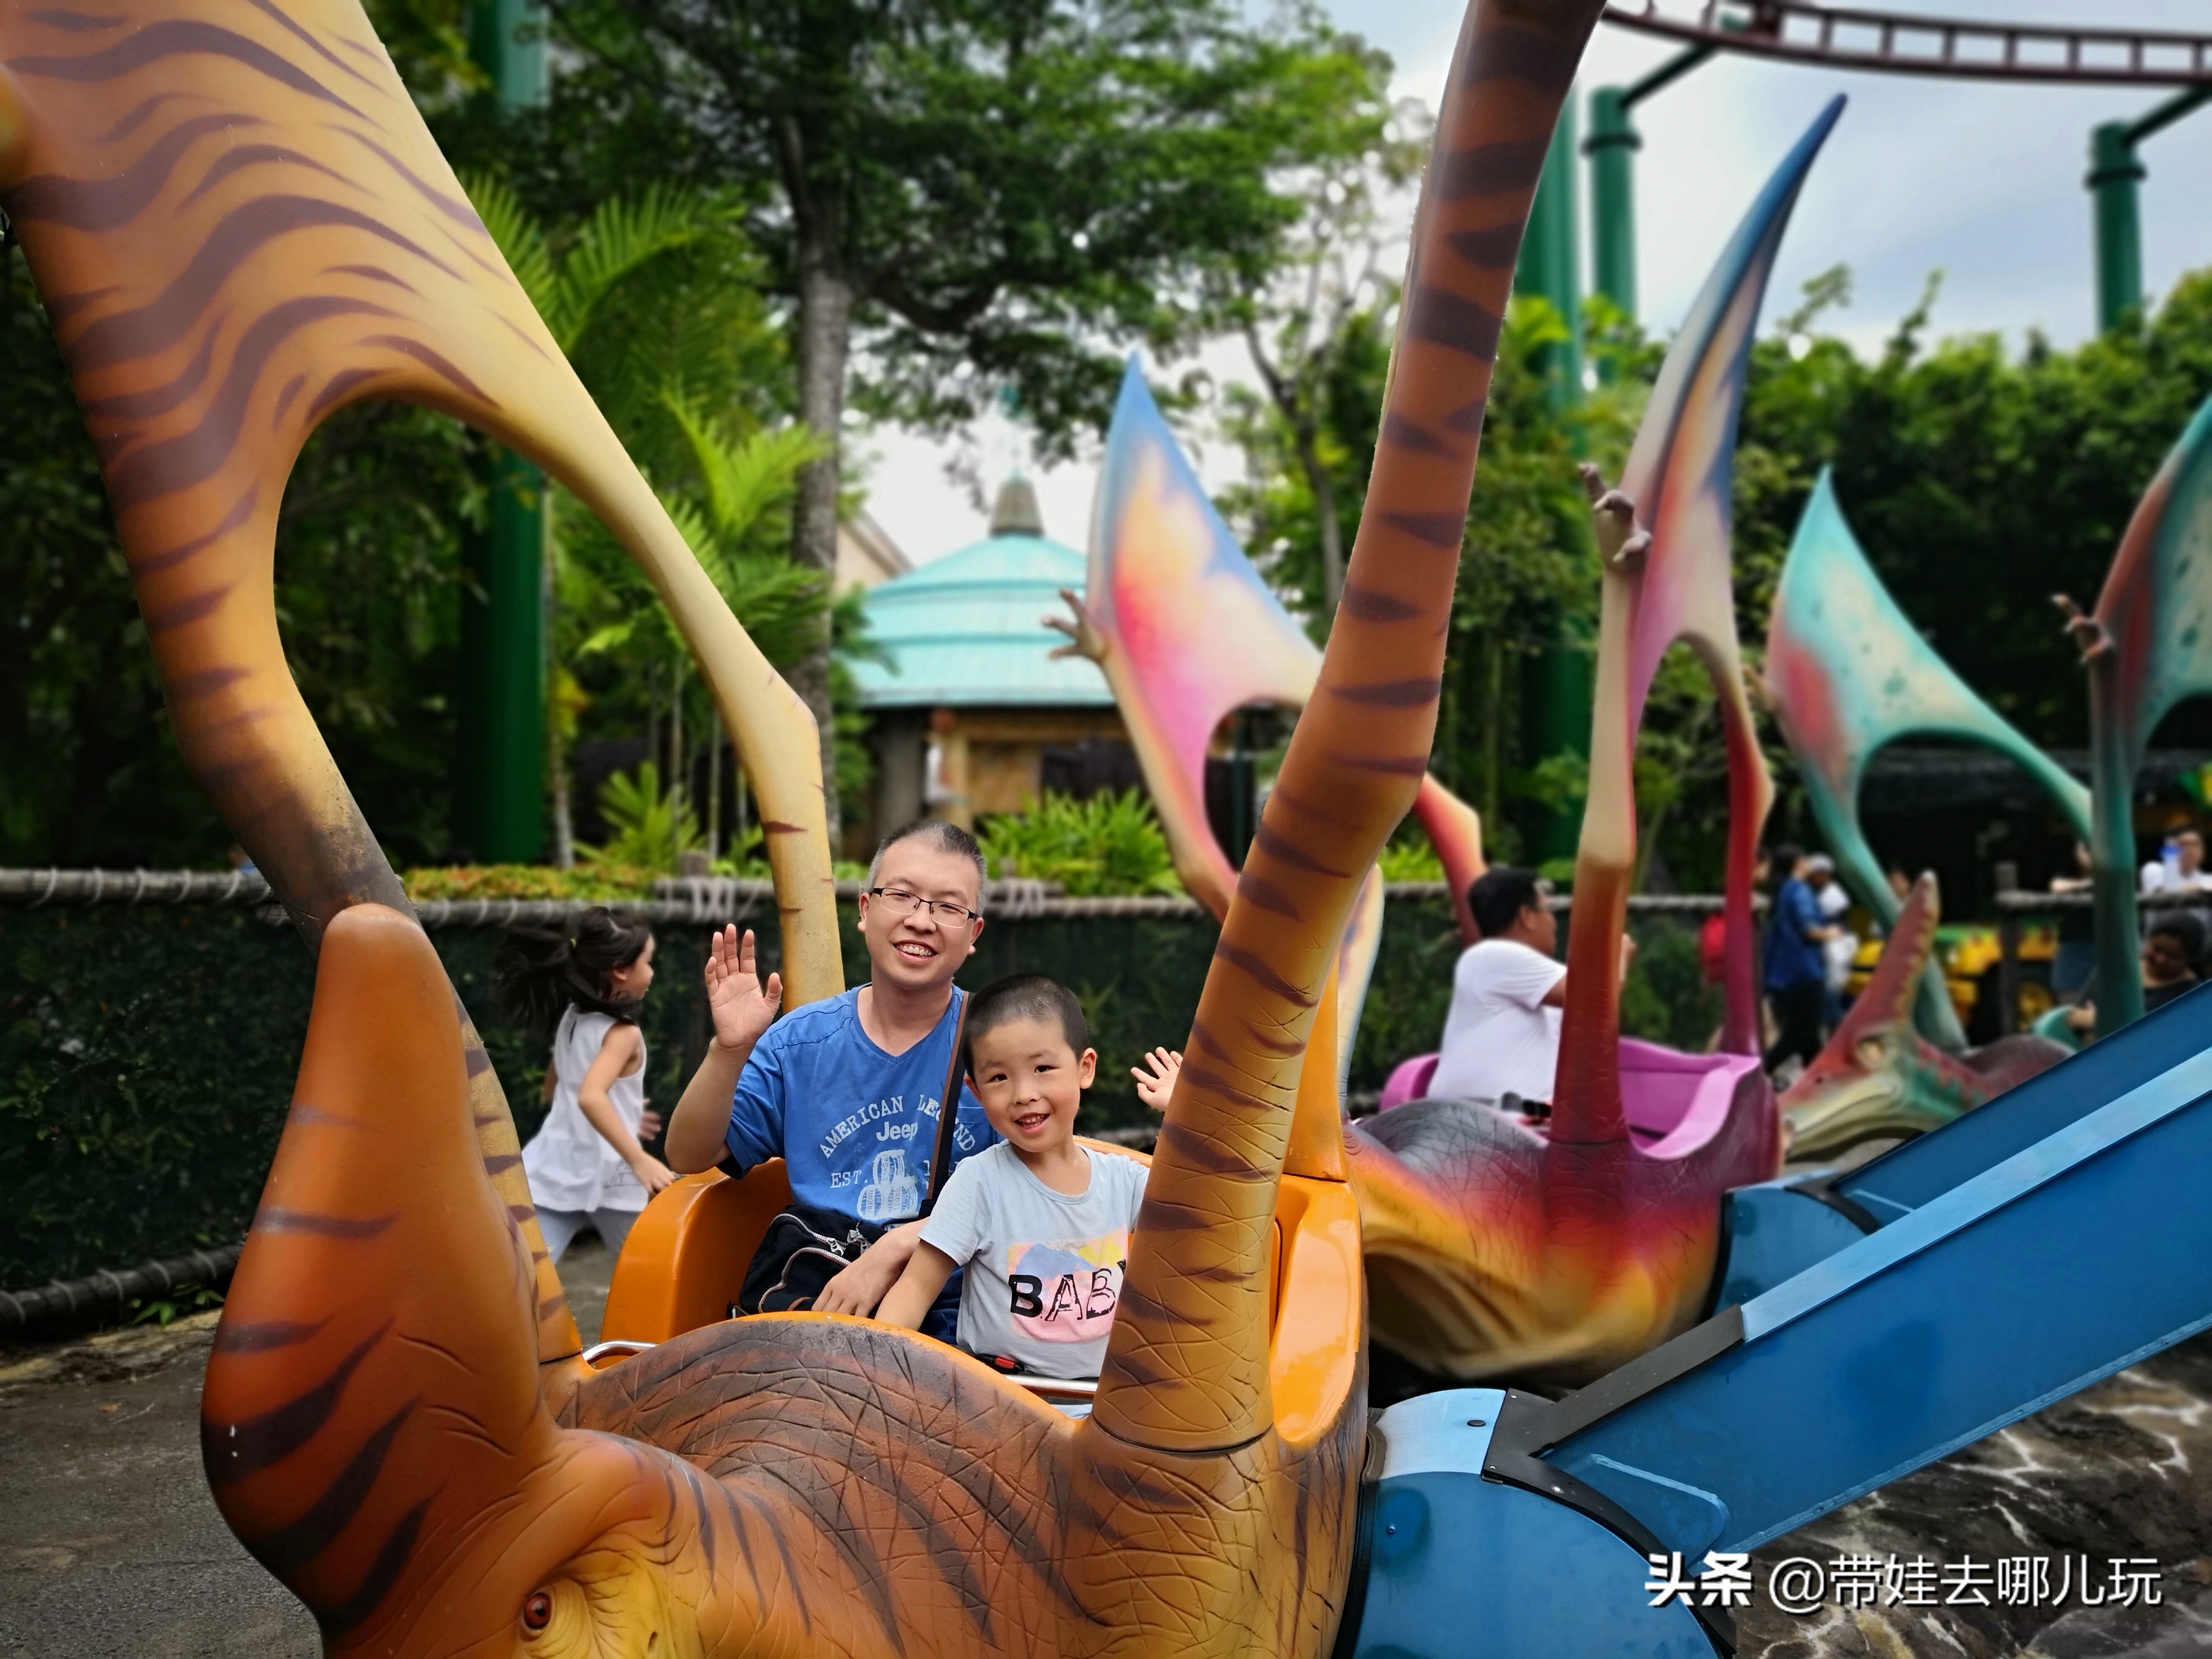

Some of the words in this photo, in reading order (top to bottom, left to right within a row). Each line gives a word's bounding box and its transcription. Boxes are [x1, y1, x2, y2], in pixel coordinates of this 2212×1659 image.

[819, 1095, 903, 1158] AMERICAN
[917, 1094, 976, 1151] LEND
[876, 1121, 919, 1141] Jeep
[830, 1170, 868, 1189] EST.
[1008, 1259, 1127, 1322] BAB
